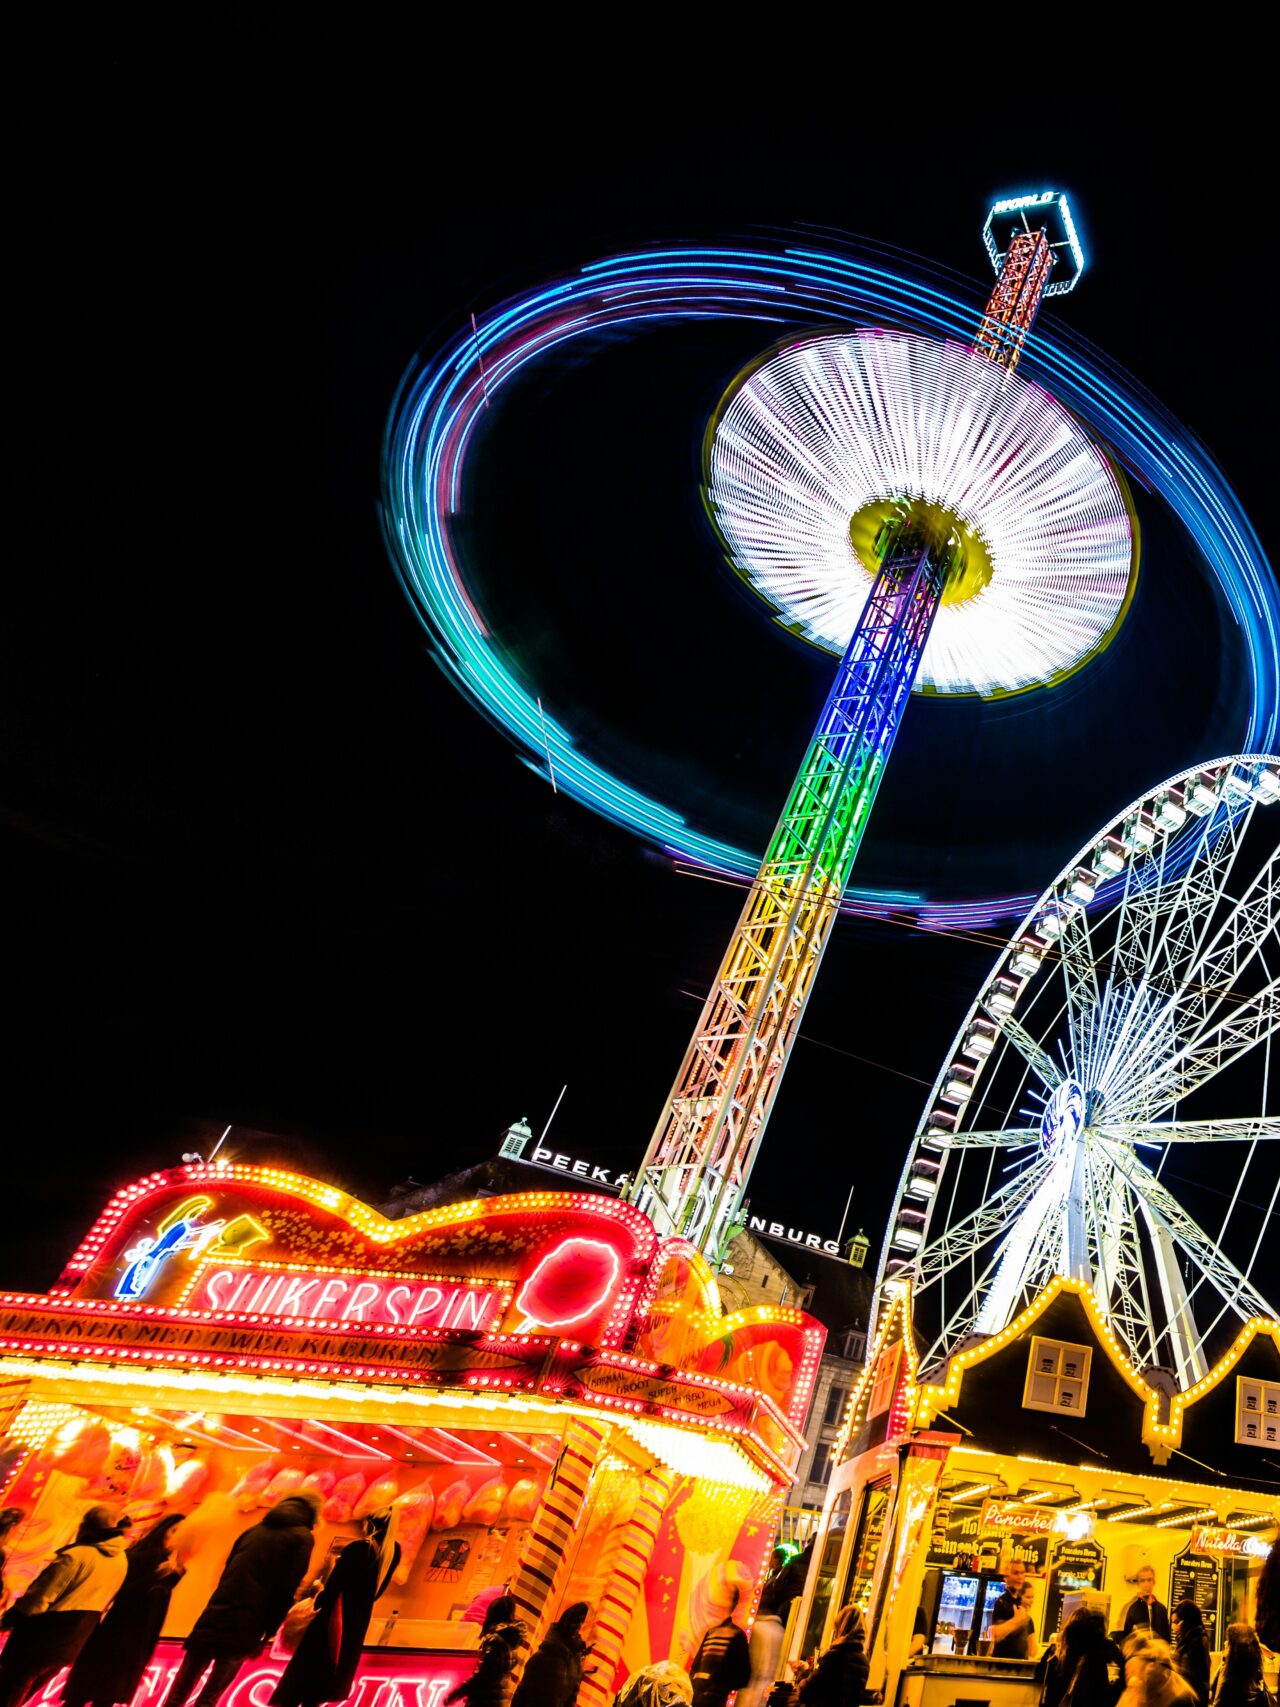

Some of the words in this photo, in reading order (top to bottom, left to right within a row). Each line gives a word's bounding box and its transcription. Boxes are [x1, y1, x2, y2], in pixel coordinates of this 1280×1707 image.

[993, 192, 1054, 213] WORLD
[531, 1147, 611, 1183] PEEK
[206, 1270, 492, 1330] SUIKERSPIN
[4, 1314, 130, 1341] LEKKER
[136, 1325, 201, 1345] MET
[208, 1331, 295, 1352] TWEE
[299, 1338, 439, 1363] KLEUREN
[616, 1379, 651, 1395] GROOT
[648, 1385, 678, 1399] SUPER
[673, 1390, 706, 1405] TURBO
[697, 1398, 722, 1410] MEGA
[983, 1503, 1056, 1532] Pancakes
[1195, 1533, 1241, 1551] Nutella
